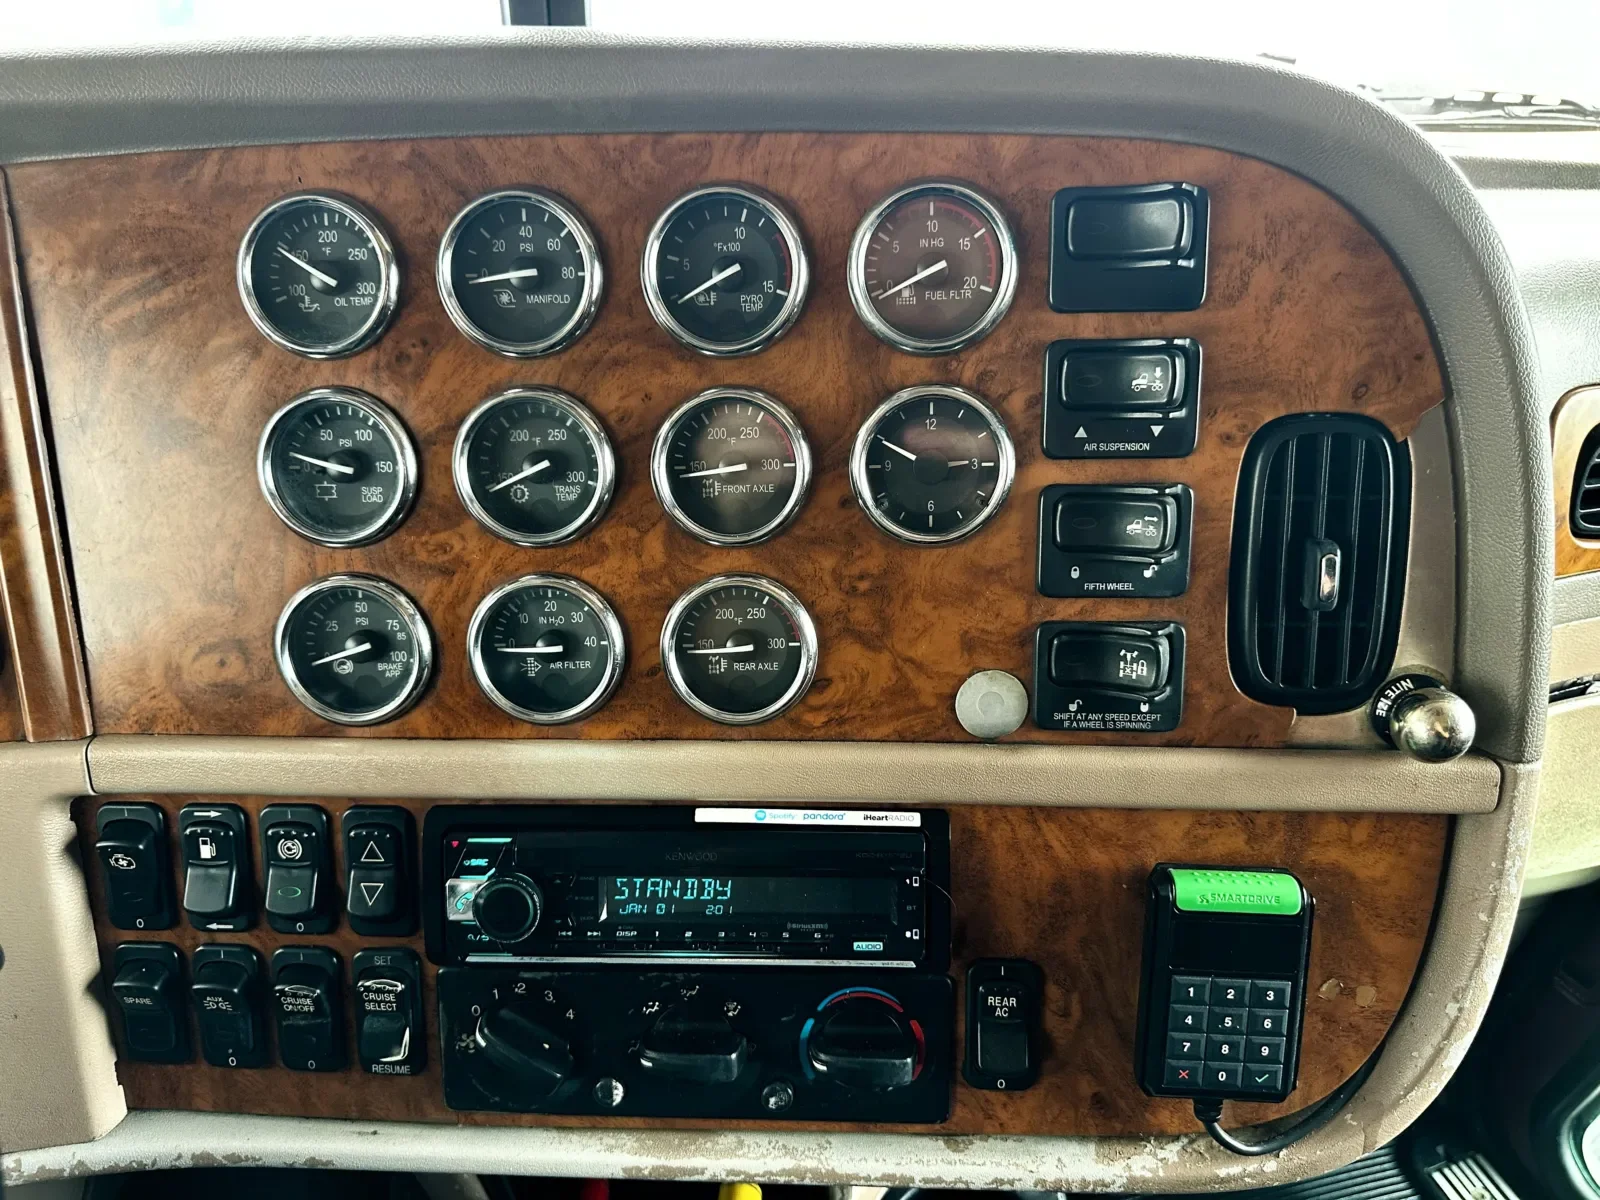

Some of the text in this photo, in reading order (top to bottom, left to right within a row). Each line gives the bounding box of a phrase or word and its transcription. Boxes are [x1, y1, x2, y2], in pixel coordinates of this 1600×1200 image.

[926, 220, 938, 232] 10
[318, 230, 338, 242] 200
[519, 226, 532, 238] 40
[734, 226, 746, 240] 10
[492, 240, 506, 252] 20
[520, 243, 534, 252] PSI
[547, 238, 560, 250] 60
[892, 241, 900, 253] 5
[920, 238, 944, 248] IN HG
[958, 238, 970, 250] 15
[348, 248, 368, 260] 250
[684, 258, 690, 270] 5
[562, 266, 575, 279] 80
[762, 280, 774, 292] 15
[964, 276, 977, 288] 20
[288, 284, 306, 296] 100
[356, 282, 376, 294] 300
[526, 294, 570, 304] MANIFOLD
[740, 294, 764, 303] PYRO
[925, 290, 972, 300] FUEL FLTR
[334, 297, 374, 306] OIL TEMP
[740, 303, 763, 312] TEMP
[925, 418, 936, 430] 12
[320, 429, 333, 440] 50
[354, 430, 372, 440] 100
[510, 430, 529, 442] 200
[548, 429, 566, 440] 250
[708, 428, 726, 440] 200
[740, 427, 760, 438] 250
[340, 438, 352, 447] PSI
[1084, 442, 1150, 451] AIR SUSPENSION
[375, 462, 392, 472] 150
[690, 460, 706, 472] 150
[761, 458, 780, 470] 300
[885, 460, 892, 472] 9
[971, 458, 978, 470] 3
[566, 471, 584, 482] 300
[362, 486, 382, 494] SUSP
[554, 485, 580, 494] TRANS
[722, 484, 774, 494] FRONT AXLE
[362, 494, 383, 502] LOAD
[556, 493, 578, 502] TEMP
[928, 500, 934, 512] 6
[1084, 582, 1134, 590] FIFTH WHEEL
[354, 602, 368, 613] 50
[544, 600, 556, 612] 20
[518, 613, 528, 624] 10
[570, 612, 584, 622] 30
[716, 608, 734, 620] 200
[746, 608, 766, 619] 250
[356, 618, 368, 626] PSI
[386, 620, 400, 630] 75
[538, 616, 547, 624] IN
[326, 620, 338, 632] 25
[396, 632, 406, 640] 85
[584, 636, 596, 647] 40
[698, 638, 714, 650] 150
[767, 638, 785, 649] 300
[390, 650, 407, 662] 100
[378, 662, 403, 670] BRAKE
[550, 660, 592, 669] AIR FILTER
[734, 662, 778, 671] REAR AXLE
[1376, 678, 1414, 718] NITE IZE
[1131, 714, 1161, 722] EXCEPT
[1115, 721, 1152, 730] SPINNING
[803, 812, 844, 821] pandora
[614, 878, 732, 900] STANDBY
[1210, 892, 1281, 904] SMARTDRIVE
[620, 904, 648, 914] JAN
[374, 956, 392, 965] SET
[517, 982, 526, 994] 2
[1188, 986, 1194, 997] 1
[1226, 988, 1235, 999] 2
[363, 992, 396, 1002] CRUISE
[492, 988, 498, 1000] 1
[544, 990, 554, 1002] 3
[1266, 990, 1274, 1001] 3
[124, 996, 153, 1005] SPARE
[280, 996, 313, 1006] CRUISE
[988, 996, 1016, 1008] REAR
[364, 1002, 396, 1011] SELECT
[995, 1007, 1008, 1017] AC
[566, 1008, 574, 1020] 4
[1184, 1014, 1192, 1025] 4
[1224, 1016, 1232, 1027] 5
[1264, 1018, 1272, 1028] 6
[1182, 1042, 1190, 1052] 7
[1221, 1044, 1229, 1054] 8
[1261, 1046, 1269, 1056] 9
[372, 1064, 411, 1074] RESUME
[1218, 1071, 1226, 1082] 0
